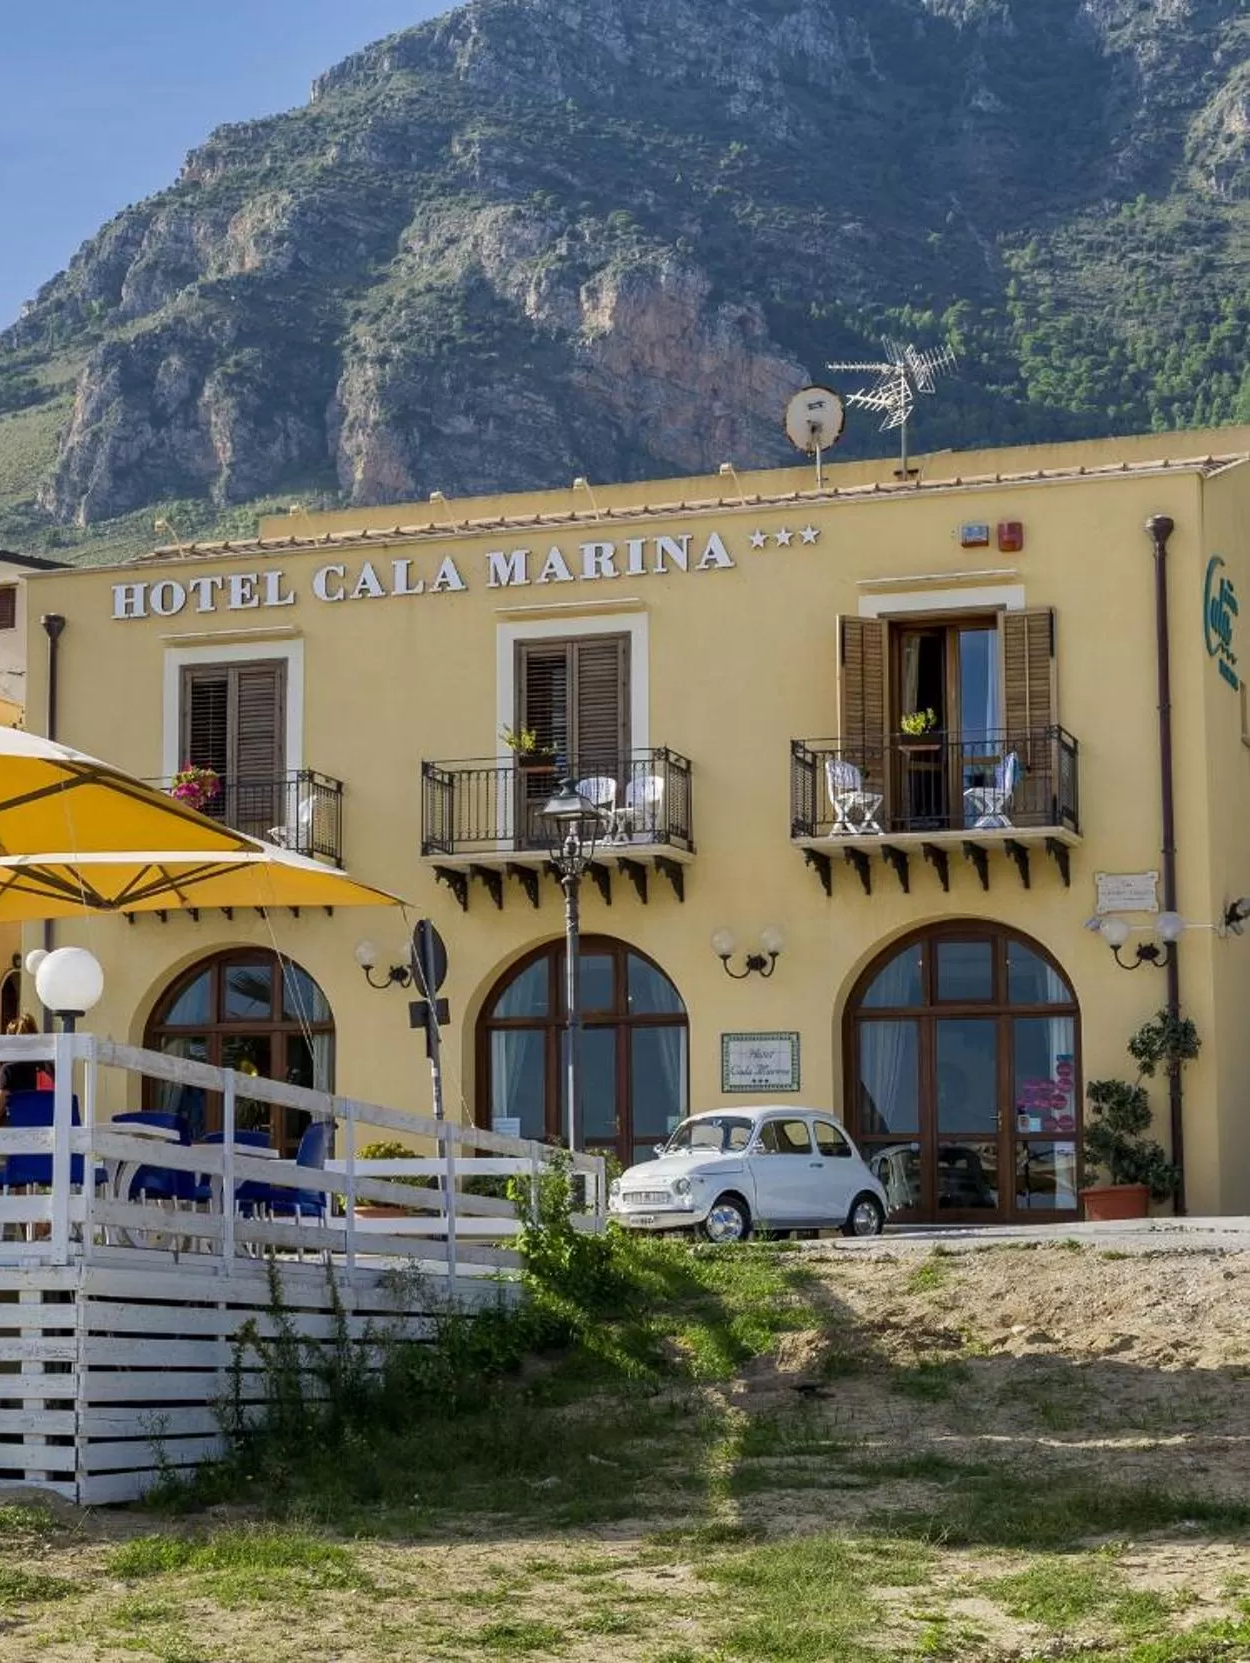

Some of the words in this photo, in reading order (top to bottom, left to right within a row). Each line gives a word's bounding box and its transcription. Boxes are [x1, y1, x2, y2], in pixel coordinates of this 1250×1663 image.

[110, 570, 296, 620] HOTEL
[312, 555, 467, 602] CALA
[485, 531, 736, 589] MARINA
